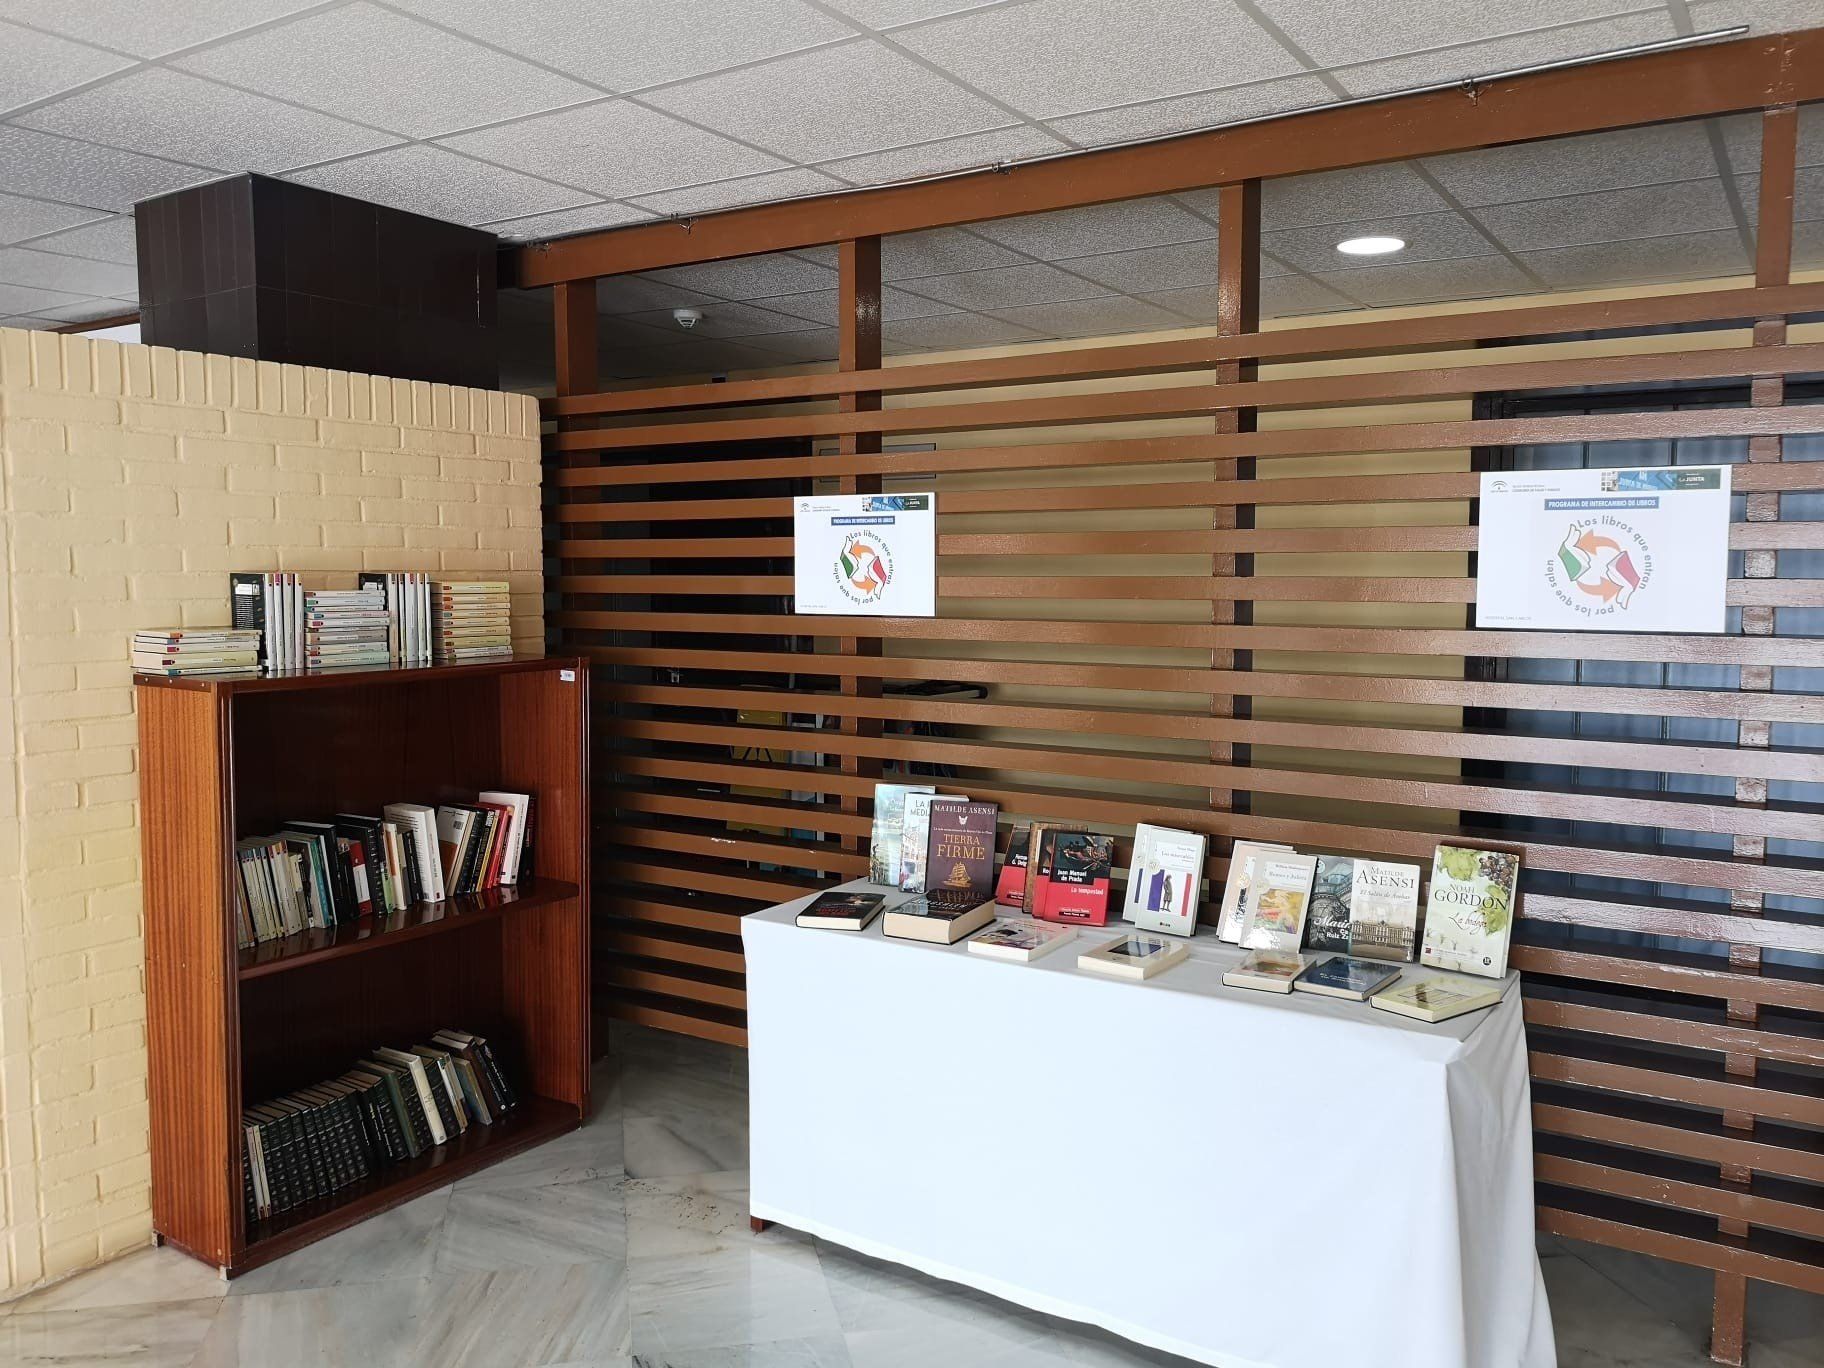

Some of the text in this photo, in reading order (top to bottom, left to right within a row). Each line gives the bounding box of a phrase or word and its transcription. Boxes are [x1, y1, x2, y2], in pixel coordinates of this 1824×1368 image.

[1548, 499, 1580, 508] PROGRAMA
[1581, 499, 1589, 507] DE
[1589, 499, 1627, 508] INTERCAMBIO
[1627, 499, 1635, 507] DE
[863, 529, 882, 543] libros
[881, 543, 891, 557] que
[886, 558, 894, 585] entran
[1577, 515, 1653, 590] Los libros que entran
[1544, 560, 1615, 617] por los que salen
[851, 595, 861, 606] los
[862, 595, 874, 604] por
[934, 804, 995, 815] MATILDE ASENSI
[943, 833, 981, 845] TIERRA
[936, 844, 985, 860] FIRME
[1057, 869, 1069, 877] Juan
[1371, 866, 1404, 877] MATILDE
[1356, 869, 1415, 889] ASENSI
[1449, 883, 1474, 893] NOAH
[1434, 889, 1507, 910] GORDON
